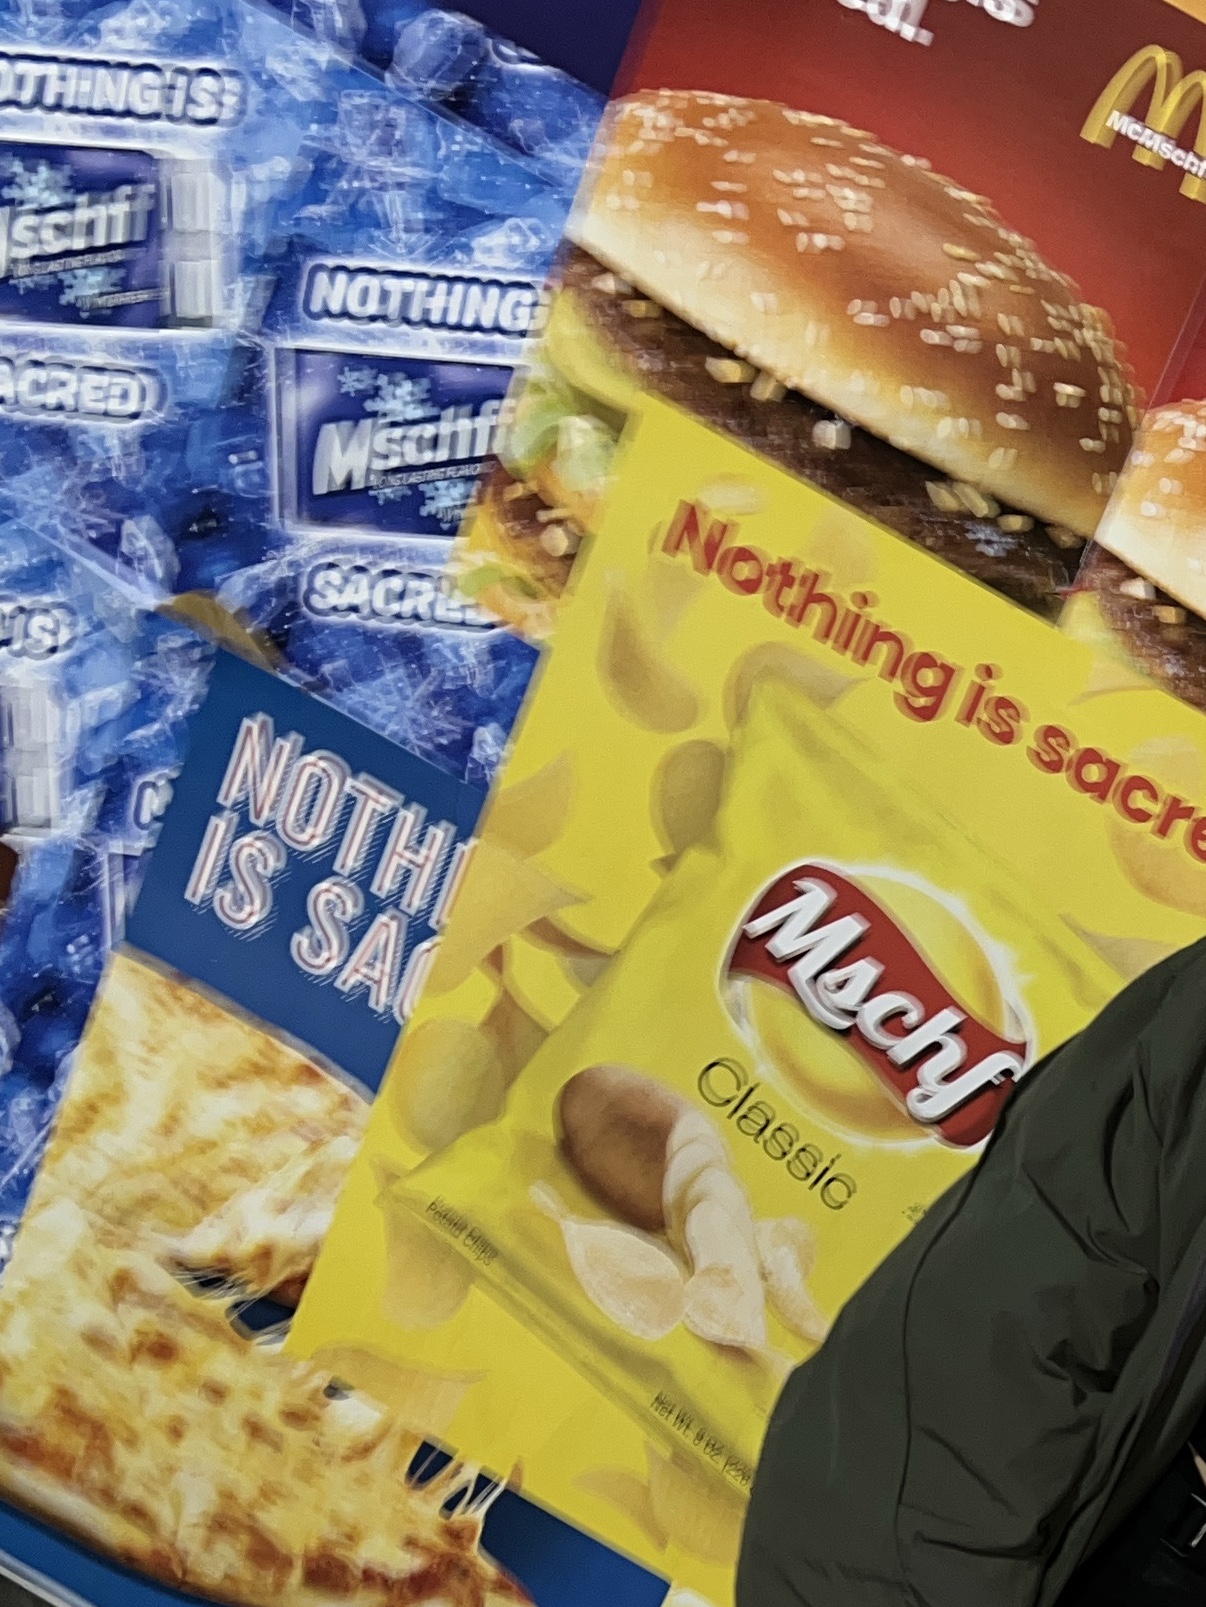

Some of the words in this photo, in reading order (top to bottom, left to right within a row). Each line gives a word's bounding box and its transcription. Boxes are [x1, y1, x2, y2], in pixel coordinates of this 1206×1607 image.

[168, 68, 236, 121] IS
[309, 270, 540, 333] NOTHING
[313, 400, 510, 497] Mschf
[660, 498, 967, 722] Nothing
[954, 661, 1030, 745] is
[185, 811, 287, 930] IS
[697, 1057, 858, 1210] Classic
